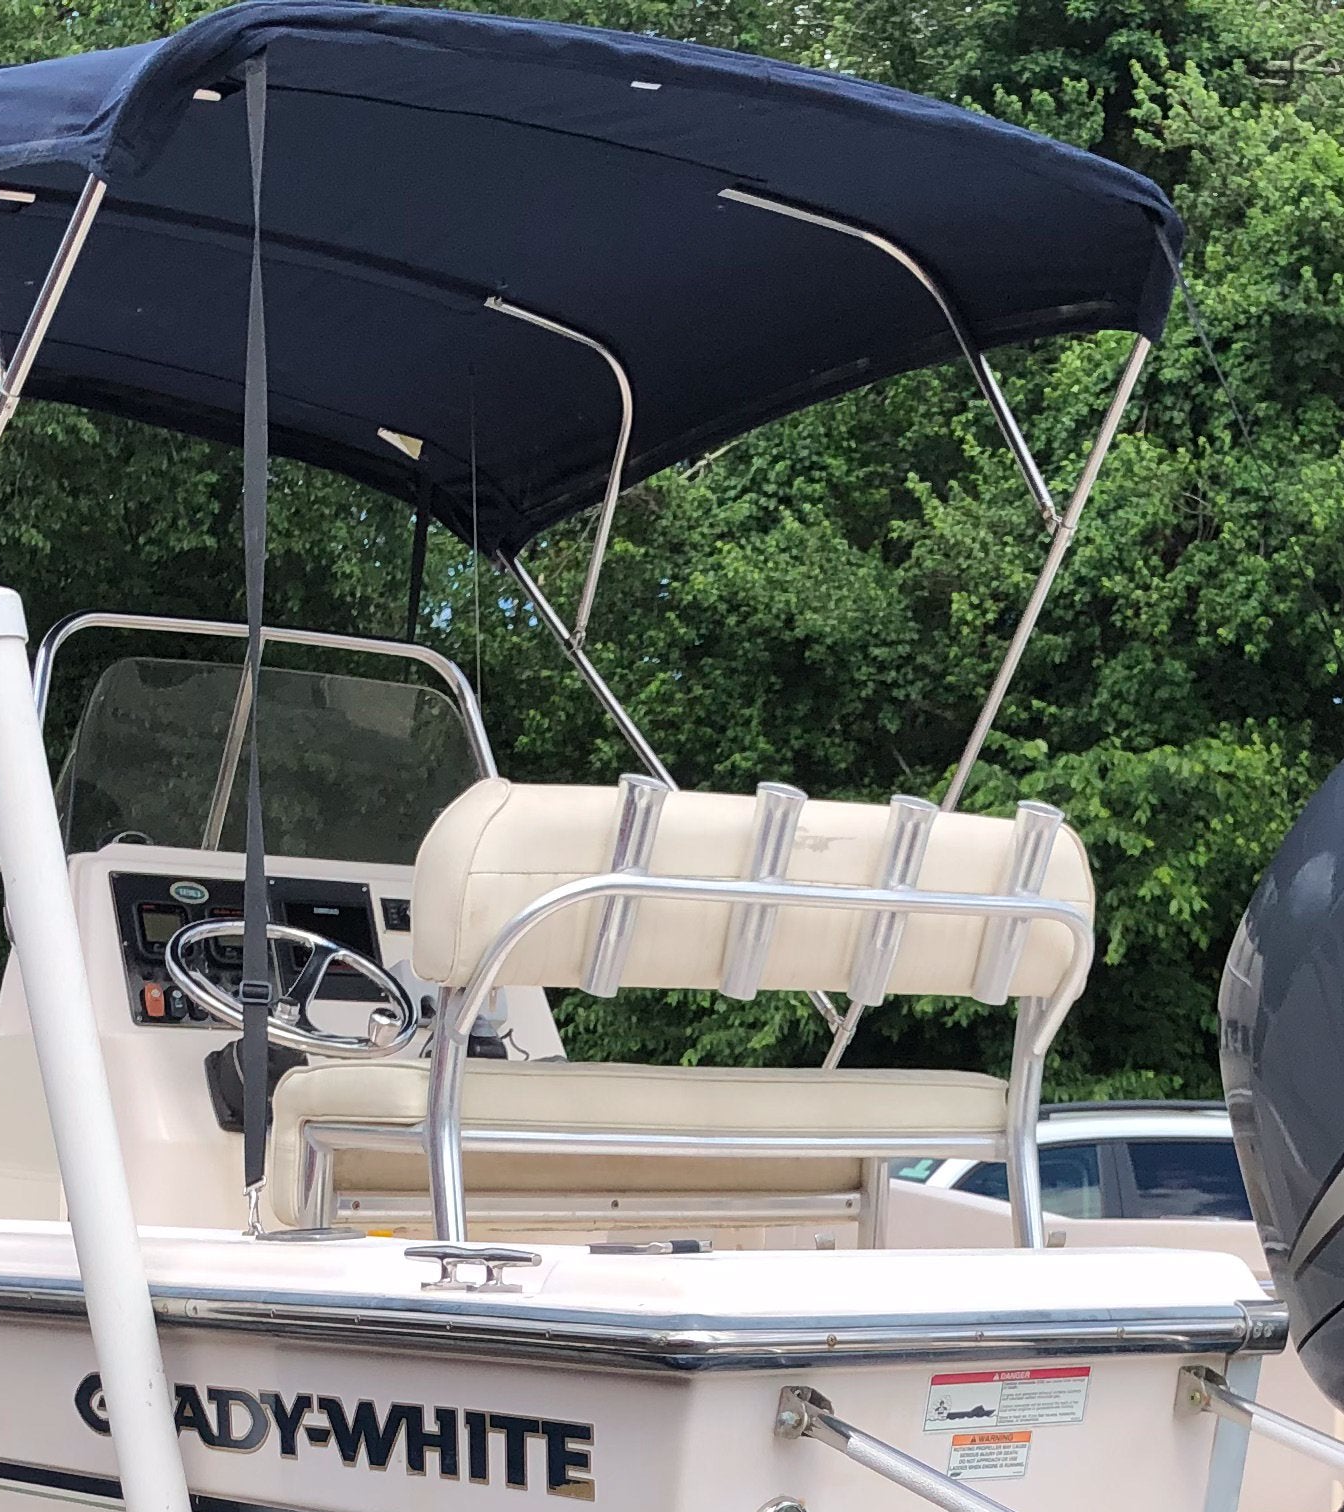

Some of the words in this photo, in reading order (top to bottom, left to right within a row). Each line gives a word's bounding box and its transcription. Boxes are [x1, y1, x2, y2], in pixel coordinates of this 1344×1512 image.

[999, 1370, 1031, 1380] DANGER
[73, 1370, 596, 1503] GADY-WHITE
[978, 1432, 1014, 1443] WARNING
